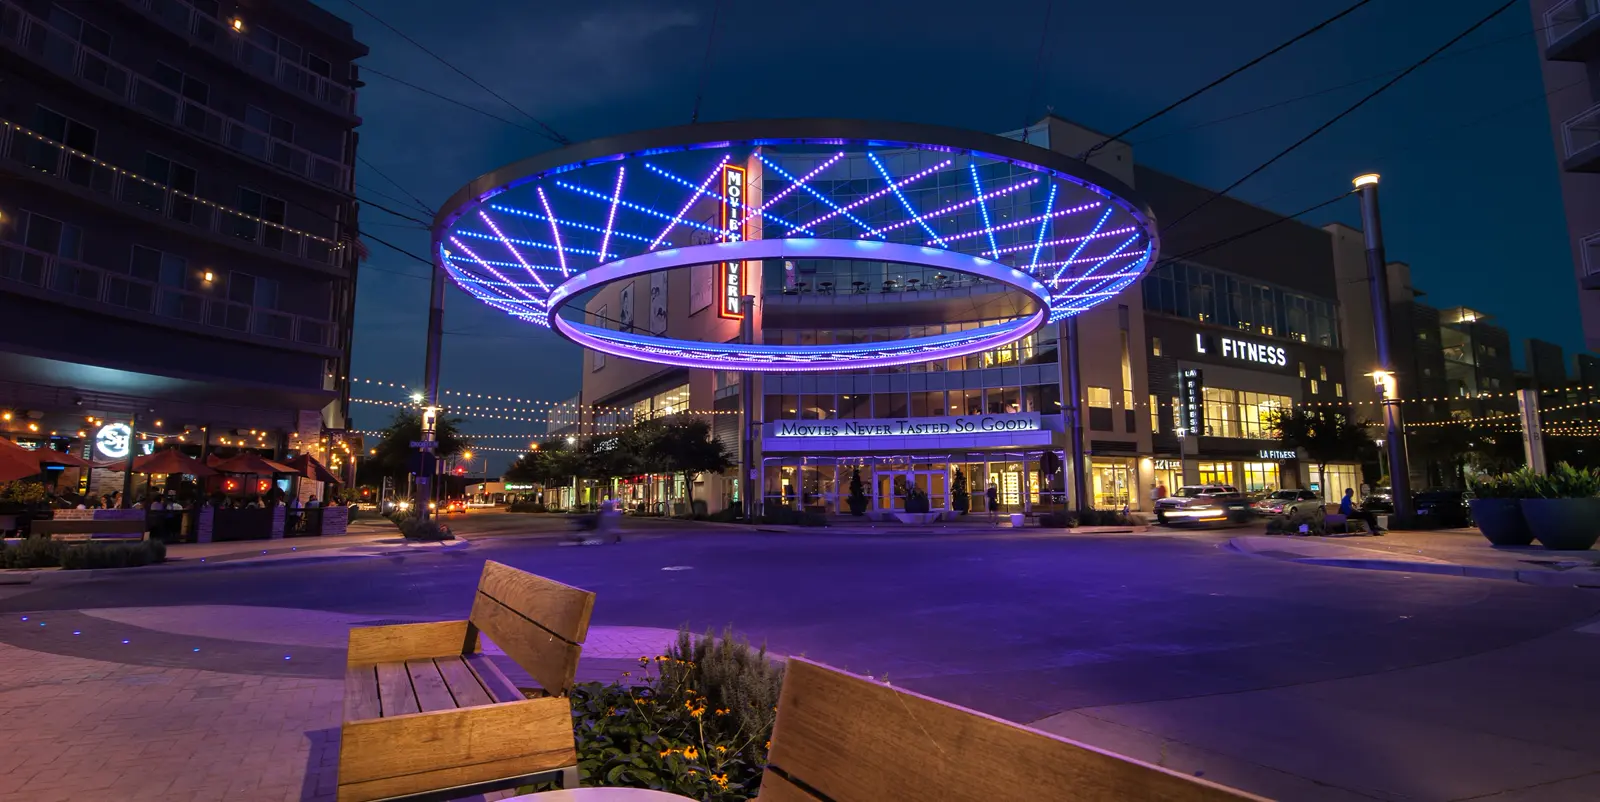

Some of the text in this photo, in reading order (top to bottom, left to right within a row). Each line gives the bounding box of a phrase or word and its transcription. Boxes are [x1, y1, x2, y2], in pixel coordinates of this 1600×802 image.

[727, 170, 741, 313] MOVIE TVERN
[1222, 338, 1286, 367] FITNESS
[1185, 369, 1198, 433] LA FITNESS
[781, 417, 1033, 436] MOVIES NEVER TASTED SO GOOD!
[1260, 449, 1296, 459] LA FITNESS
